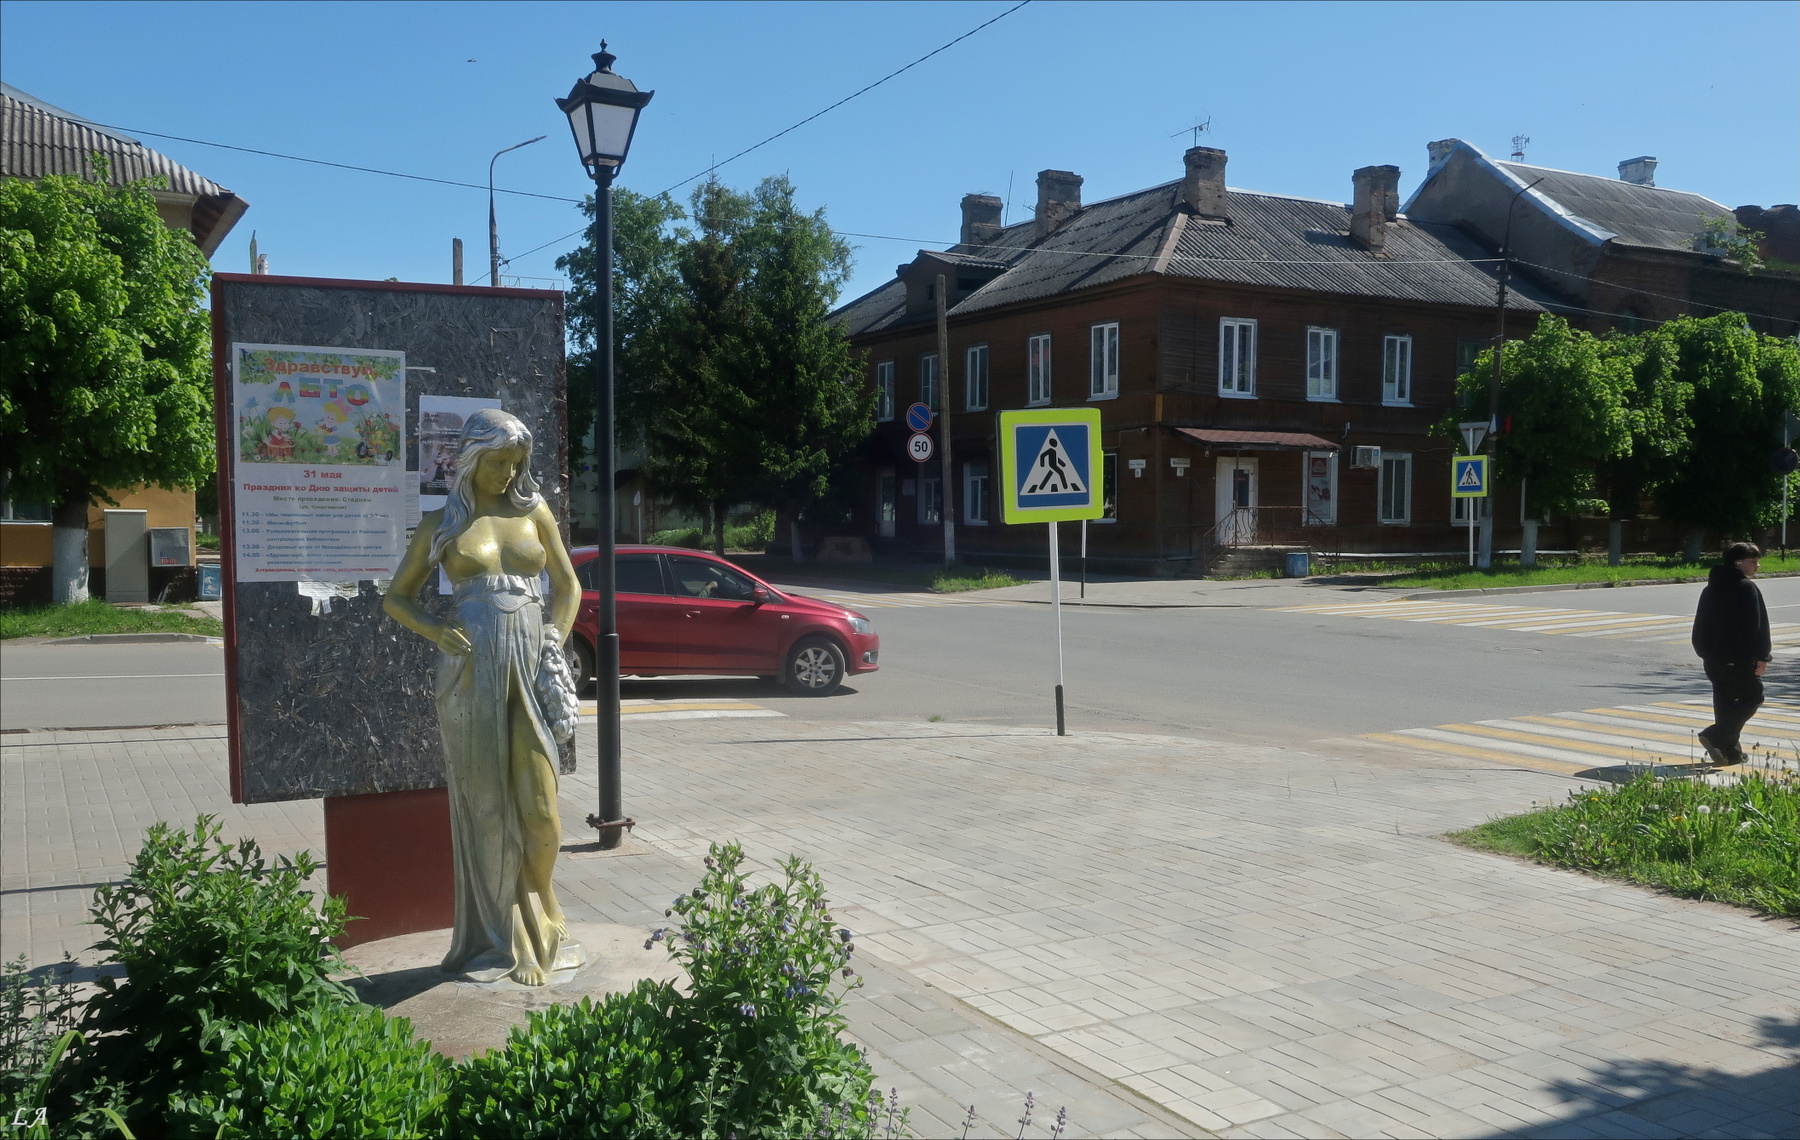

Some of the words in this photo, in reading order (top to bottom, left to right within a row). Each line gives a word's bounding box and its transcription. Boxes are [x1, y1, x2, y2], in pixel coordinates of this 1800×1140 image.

[264, 358, 379, 378] Здравствуй,
[274, 377, 369, 406] ЛЕТО
[914, 441, 928, 453] 50
[303, 469, 317, 479] 31
[320, 471, 342, 479] мая
[243, 483, 292, 493] Праздник
[309, 484, 331, 493] Дню
[333, 485, 370, 494] защиты
[372, 485, 399, 494] детей
